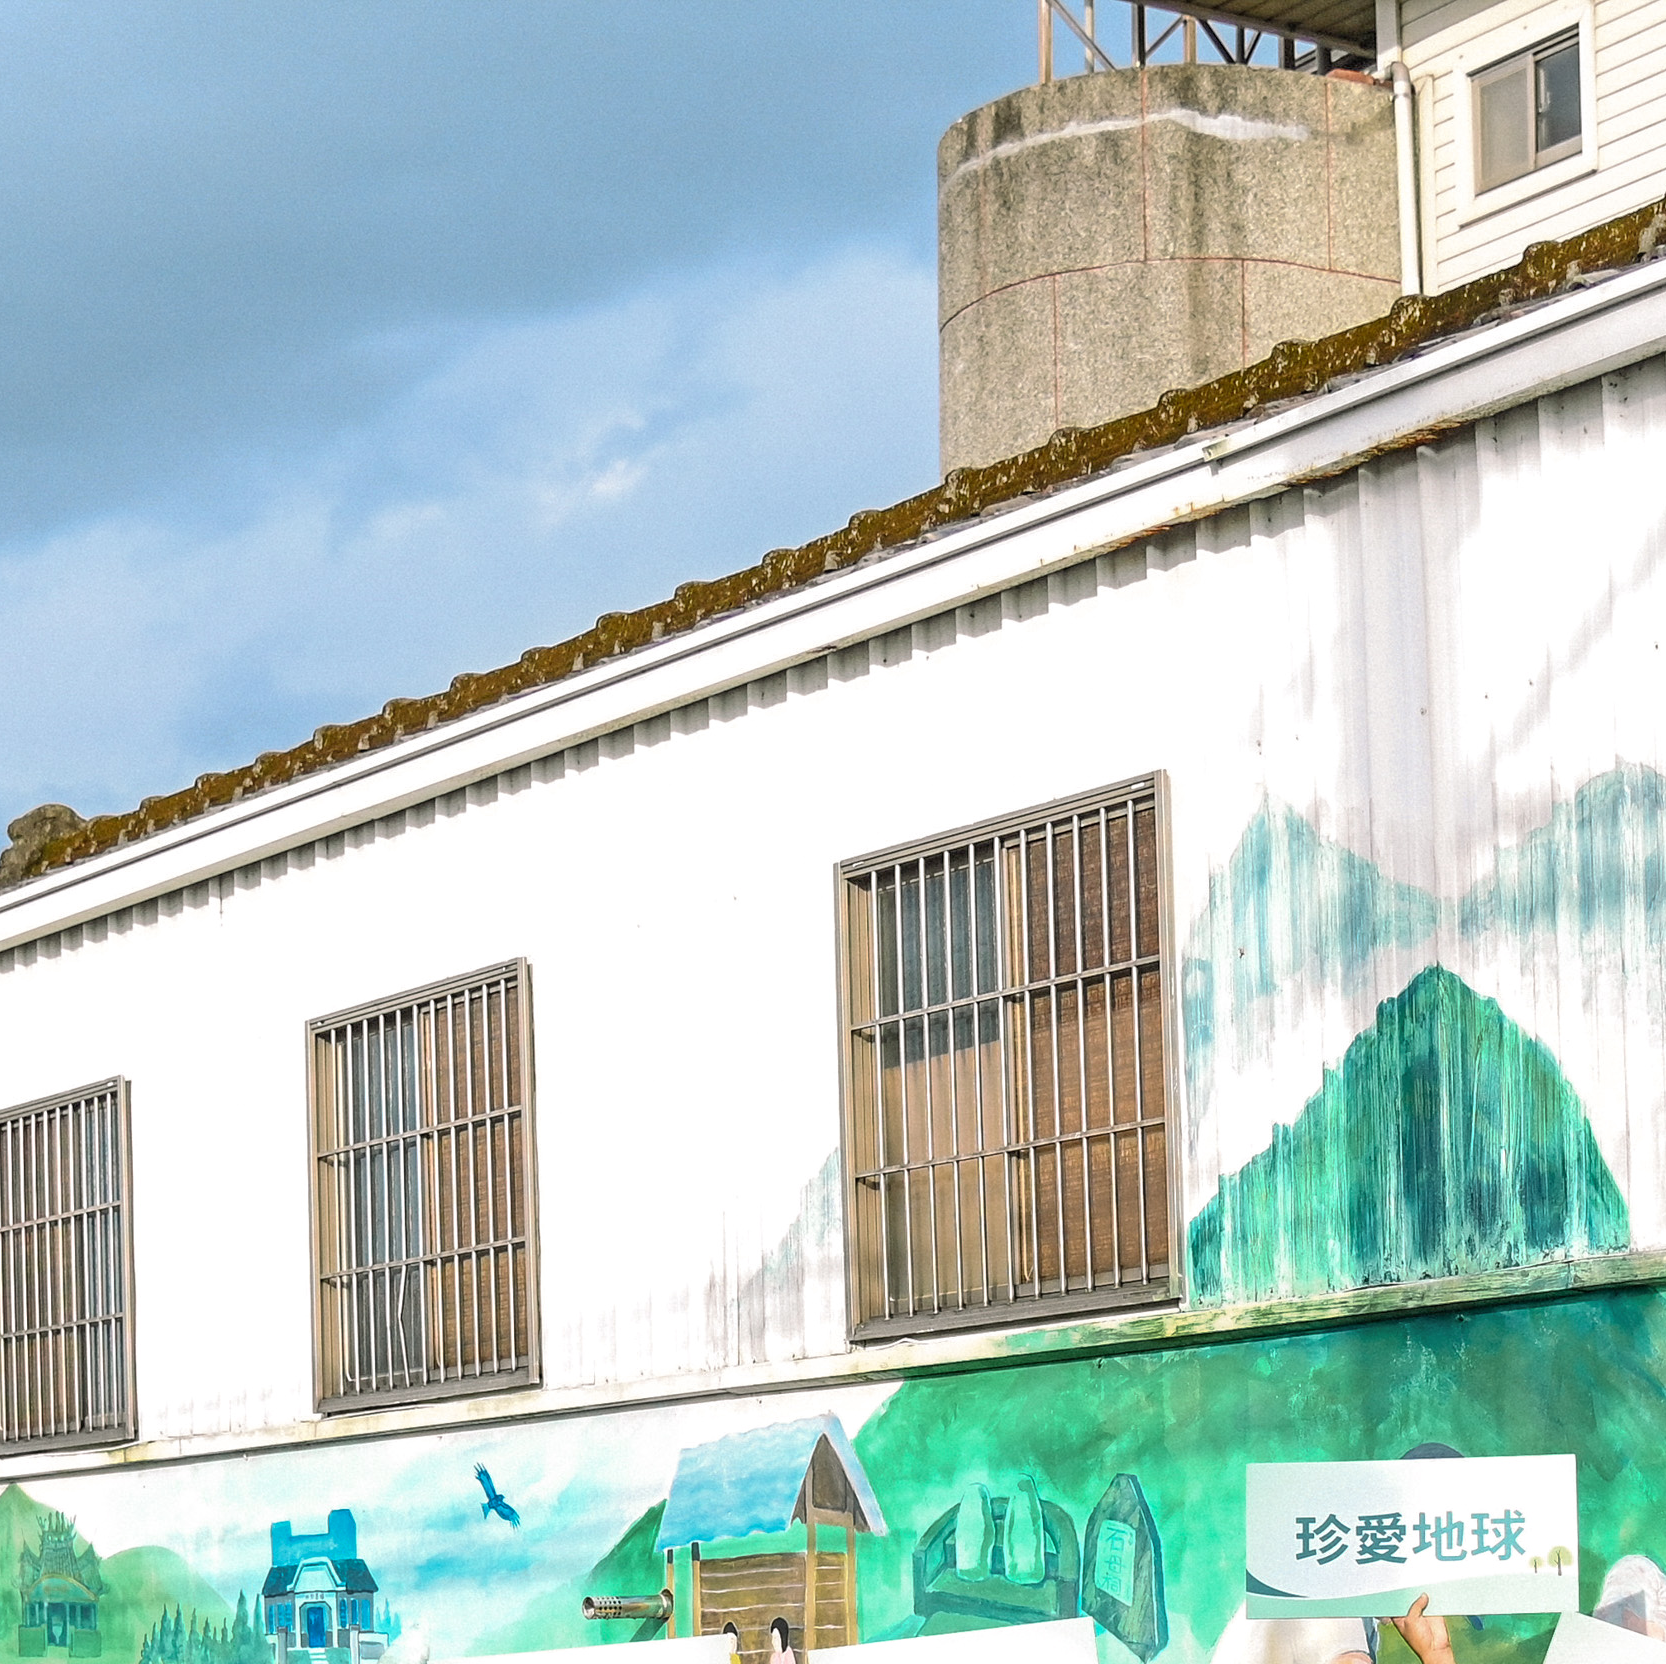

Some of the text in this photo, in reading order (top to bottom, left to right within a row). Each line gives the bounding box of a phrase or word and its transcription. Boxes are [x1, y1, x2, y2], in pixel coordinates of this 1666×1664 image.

[1098, 1525, 1126, 1595] 石母祠
[1294, 1509, 1526, 1566] 珍愛地球
